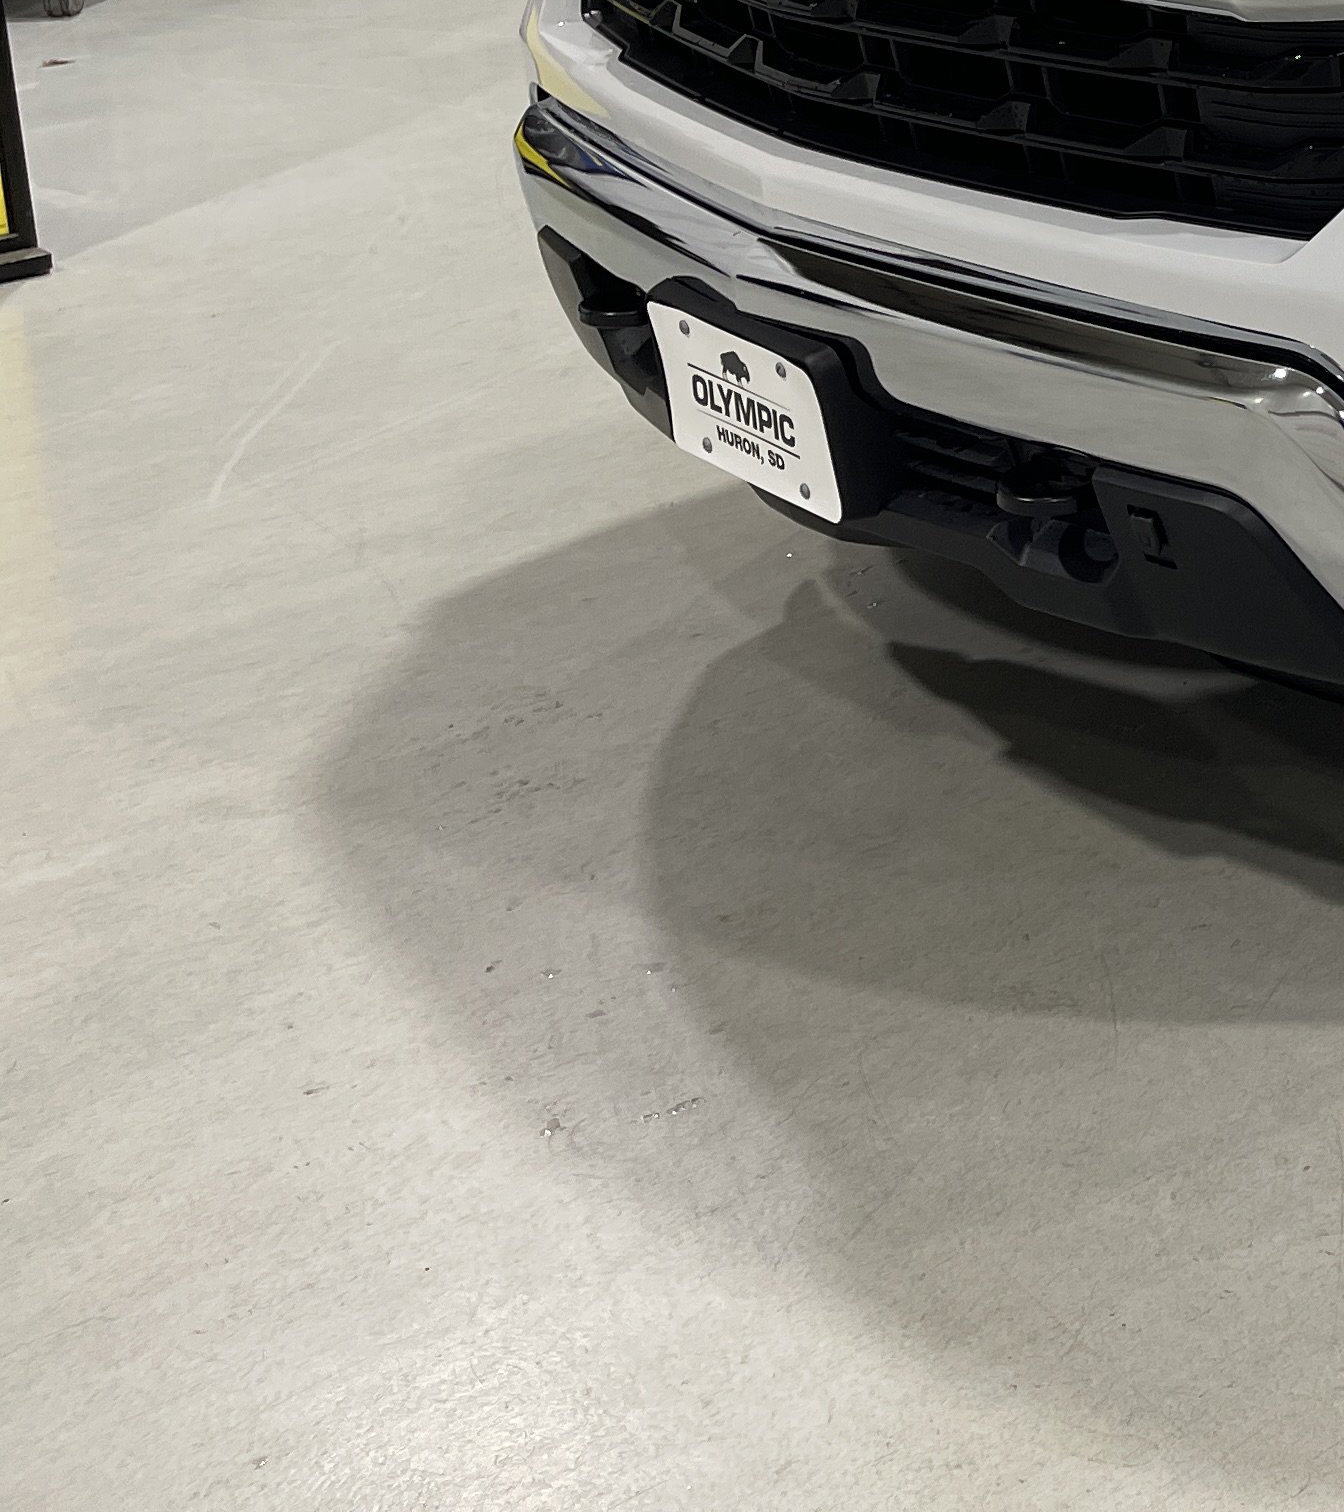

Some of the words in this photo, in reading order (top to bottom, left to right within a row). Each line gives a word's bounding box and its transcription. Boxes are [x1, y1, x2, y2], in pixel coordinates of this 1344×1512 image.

[691, 374, 796, 448] OLYMPIC
[716, 425, 765, 465] HURON,
[768, 450, 785, 470] SD
